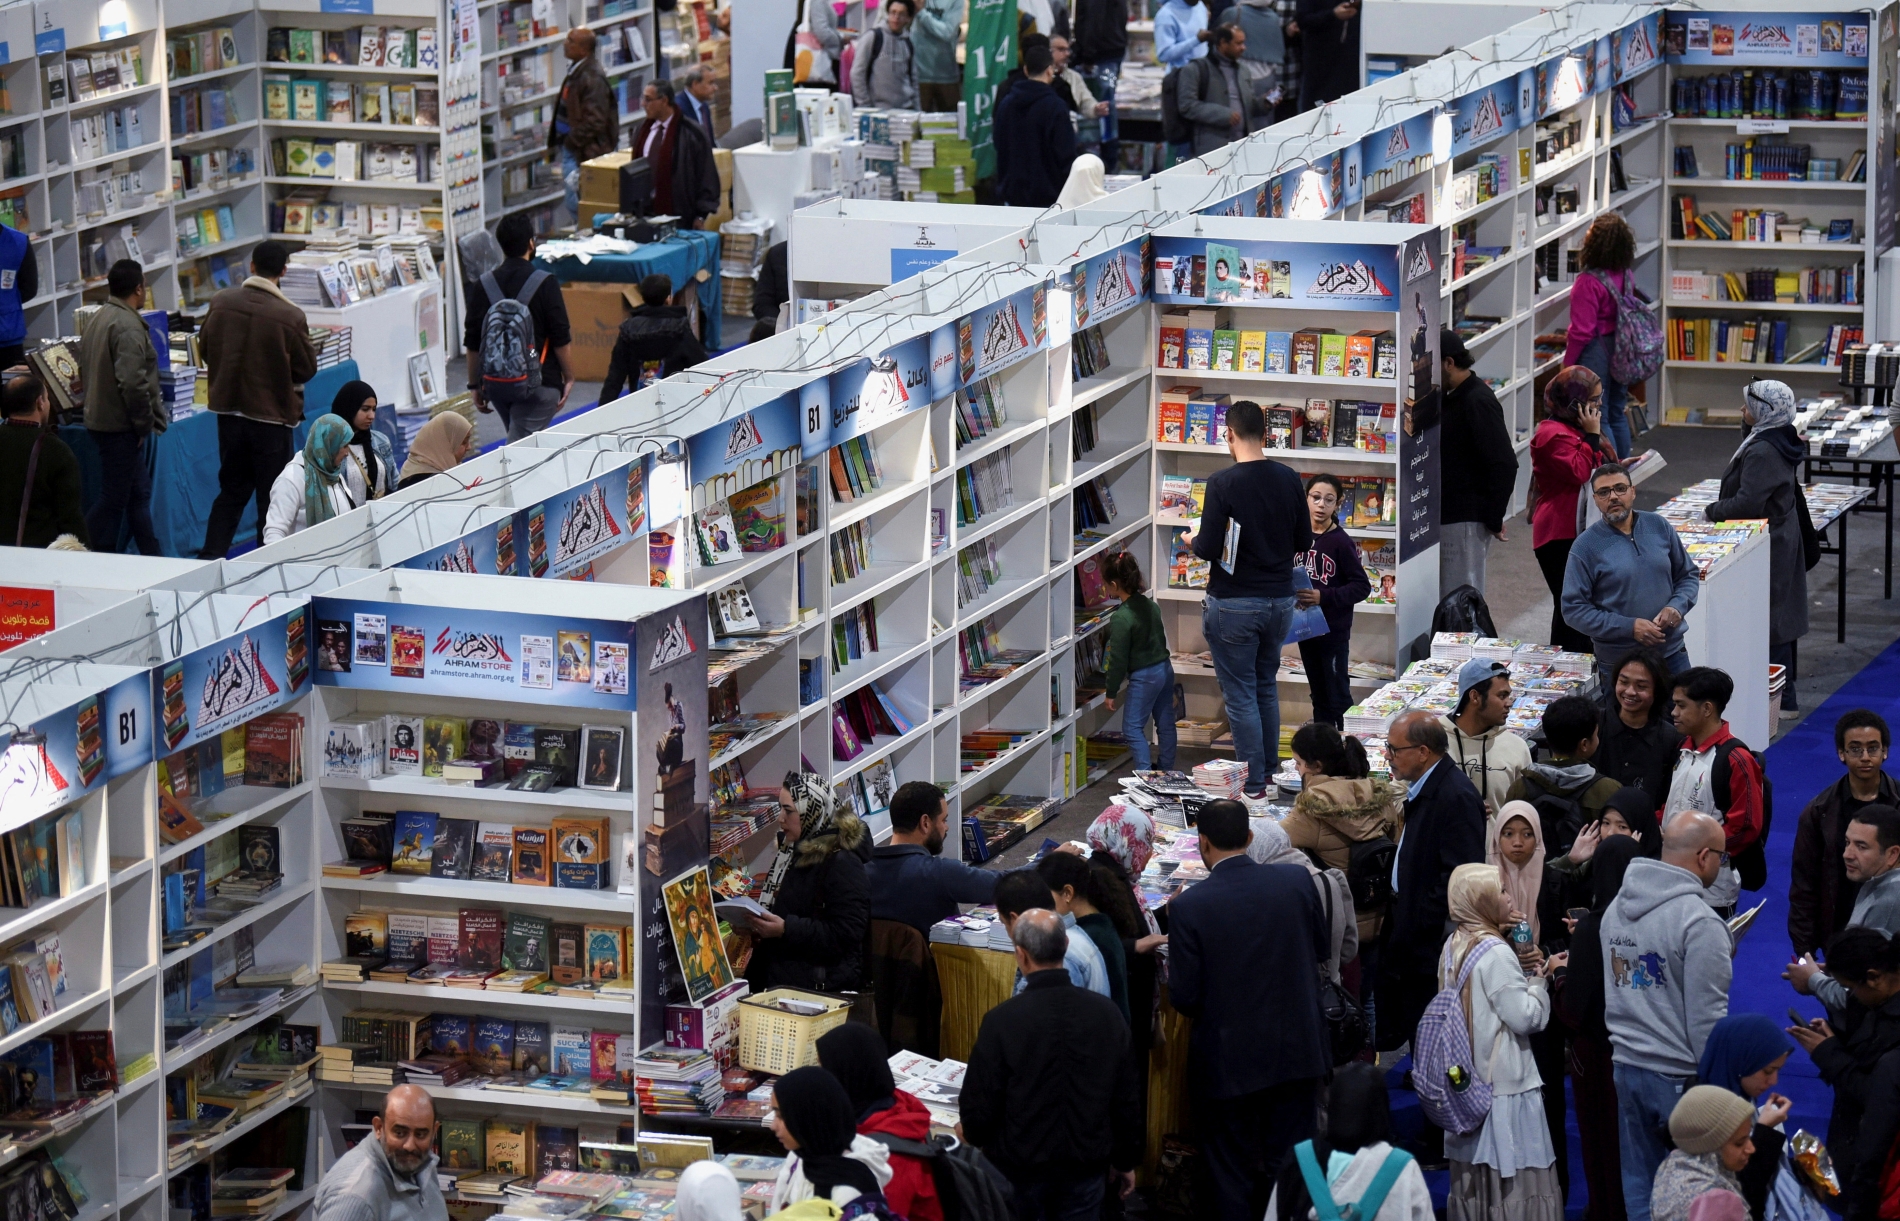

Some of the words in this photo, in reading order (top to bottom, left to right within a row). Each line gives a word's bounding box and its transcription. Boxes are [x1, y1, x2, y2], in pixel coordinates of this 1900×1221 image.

[1522, 89, 1530, 109] B1
[1349, 163, 1357, 187] B1
[564, 331, 618, 347] inston
[906, 365, 928, 389] وكالة
[832, 394, 861, 429] للتوزيع
[807, 405, 821, 434] B1
[1367, 550, 1396, 564] Vehicl
[1293, 549, 1336, 585] GAP
[2, 613, 27, 626] وتلوين
[29, 615, 50, 625] قصة
[444, 658, 480, 668] AHRAM
[481, 661, 512, 671] STORE
[430, 668, 515, 683] ahramstore.ahram.org.eg
[118, 709, 138, 746] B1
[392, 749, 417, 762] جيفارا
[517, 832, 545, 844] البؤساء
[576, 868, 596, 876] مذكرات
[513, 920, 545, 930] لافكرافت
[391, 929, 424, 937] NIETZSCHE
[556, 1040, 591, 1049] SUCCESS
[572, 1061, 591, 1069] النجاح
